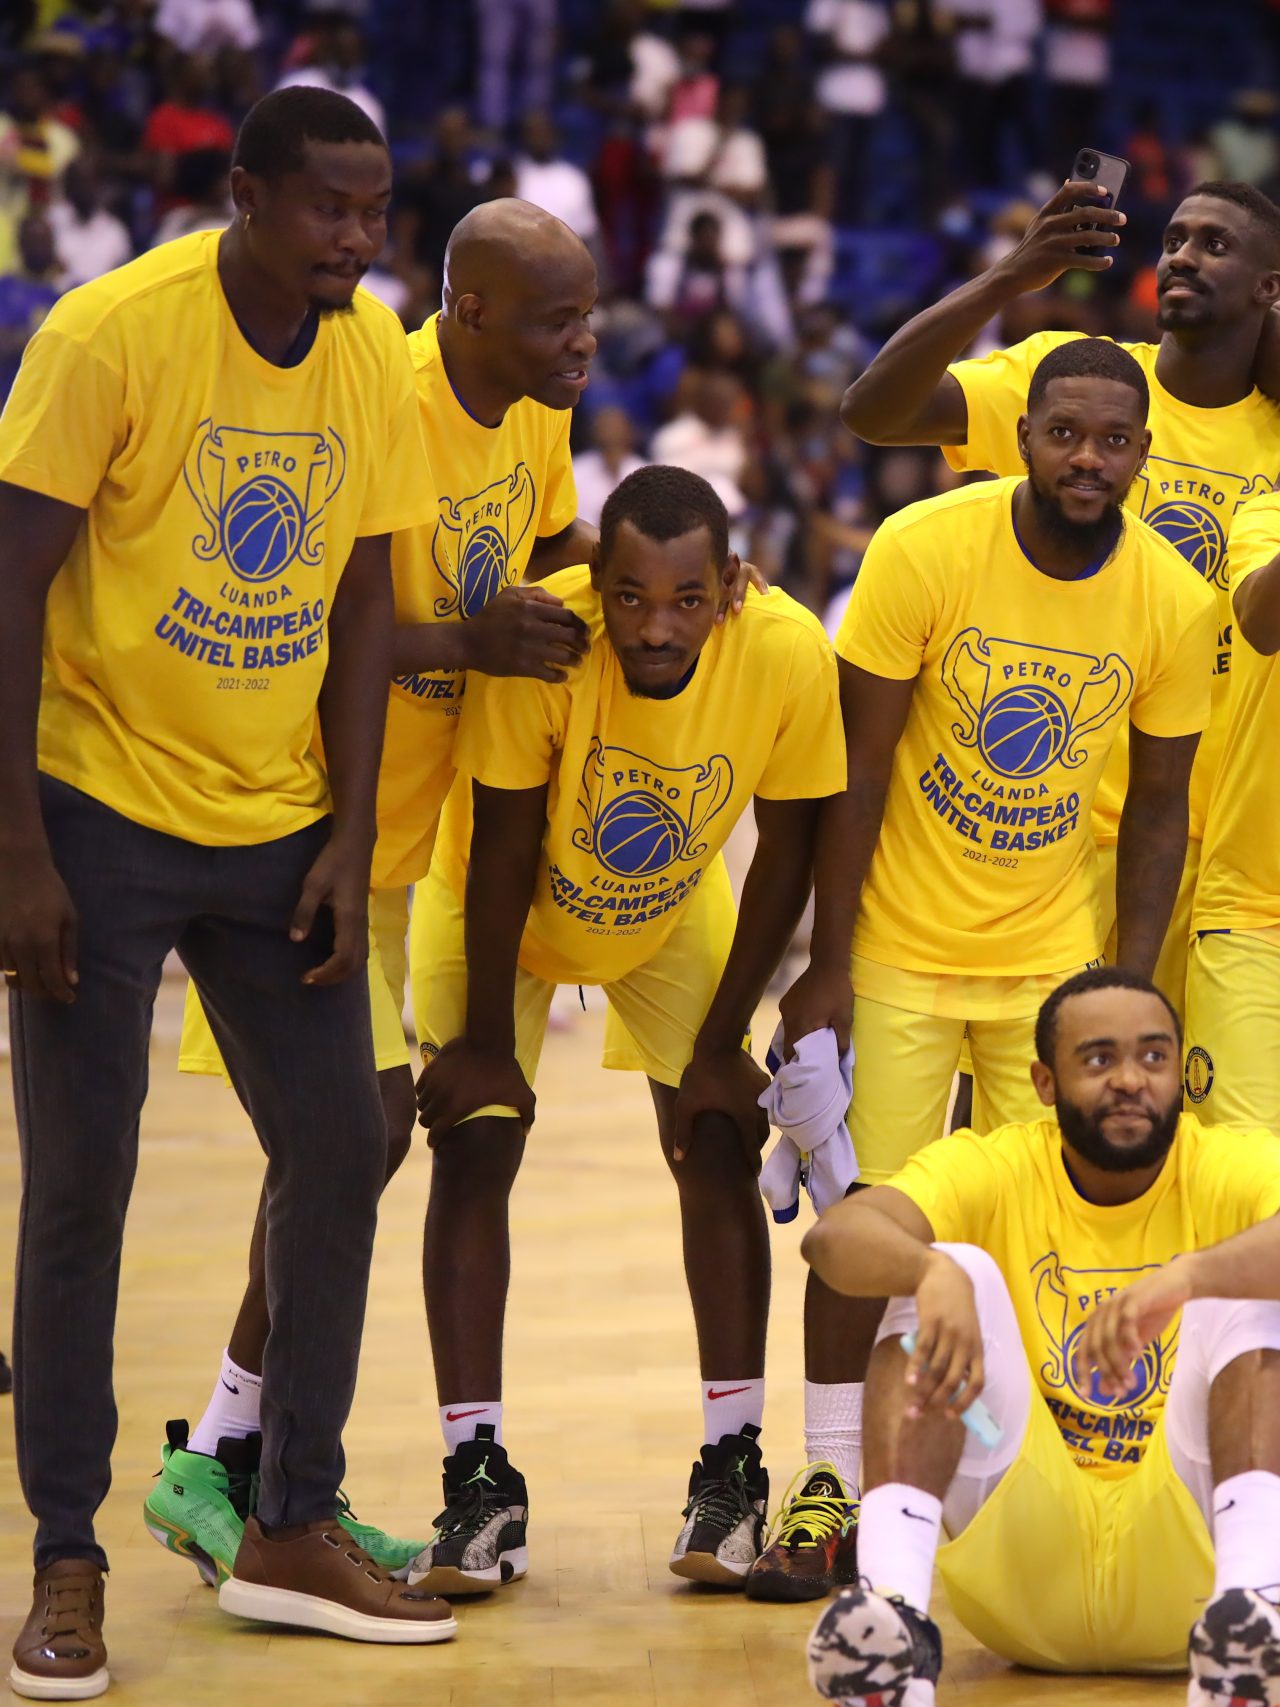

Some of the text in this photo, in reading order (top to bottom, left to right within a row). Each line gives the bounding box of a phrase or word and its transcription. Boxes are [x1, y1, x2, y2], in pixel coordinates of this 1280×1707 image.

[236, 450, 297, 474] PETRO
[1159, 480, 1225, 506] PETRO
[464, 502, 502, 535] PETRO
[219, 581, 293, 609] LUANDA
[171, 586, 324, 640] TRI-CAMPEÃO
[154, 613, 325, 670] UNITEL BASKET
[216, 677, 271, 691] 2021-2022
[1003, 662, 1072, 688] PETRO
[612, 769, 681, 800] PETRO
[932, 752, 1080, 827] TRI-CAMPEÃO
[971, 769, 1049, 800] LUANDA
[918, 770, 1079, 852] UNITEL BASKET
[962, 848, 1019, 869] 2021-2022
[590, 875, 670, 894] LUANDA
[585, 927, 642, 936] 2021-2022
